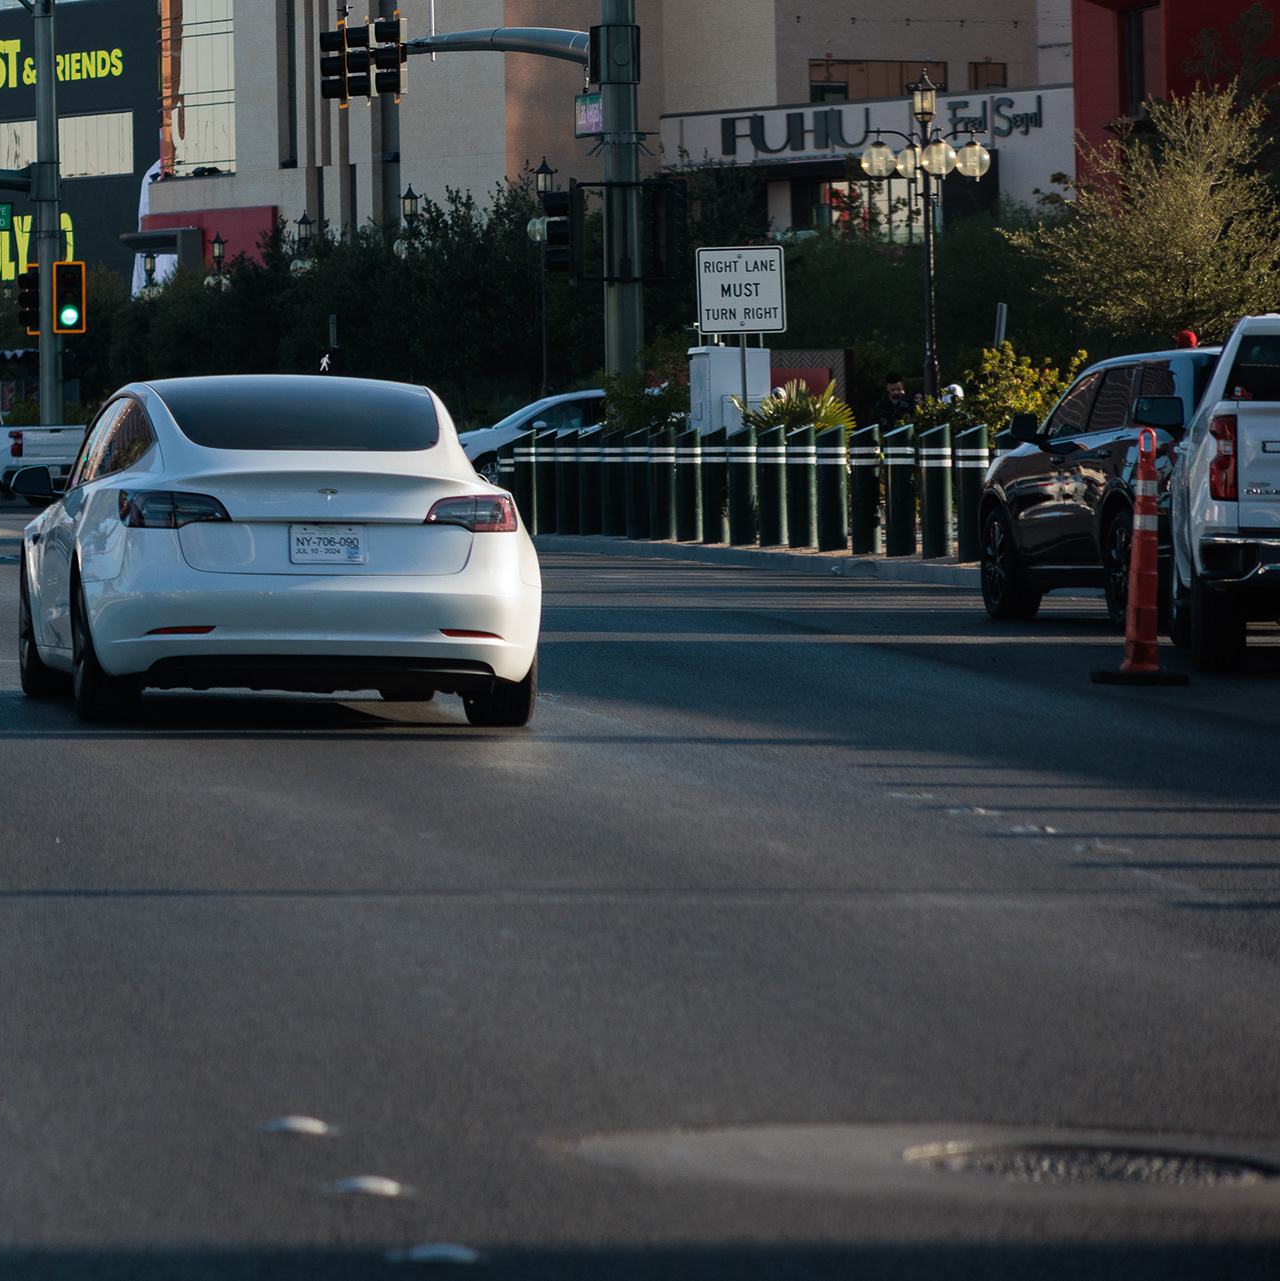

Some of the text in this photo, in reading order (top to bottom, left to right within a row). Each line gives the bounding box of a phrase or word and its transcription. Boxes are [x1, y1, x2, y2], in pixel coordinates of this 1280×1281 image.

[22, 57, 37, 85] &
[55, 48, 124, 82] RIENDS
[947, 94, 1042, 141] Fred Segal
[721, 107, 870, 156] FUHU
[704, 260, 776, 273] RIGHT LANE
[721, 282, 760, 297] MUST
[705, 307, 779, 320] TURN RIGHT
[296, 537, 360, 548] NY-706-090
